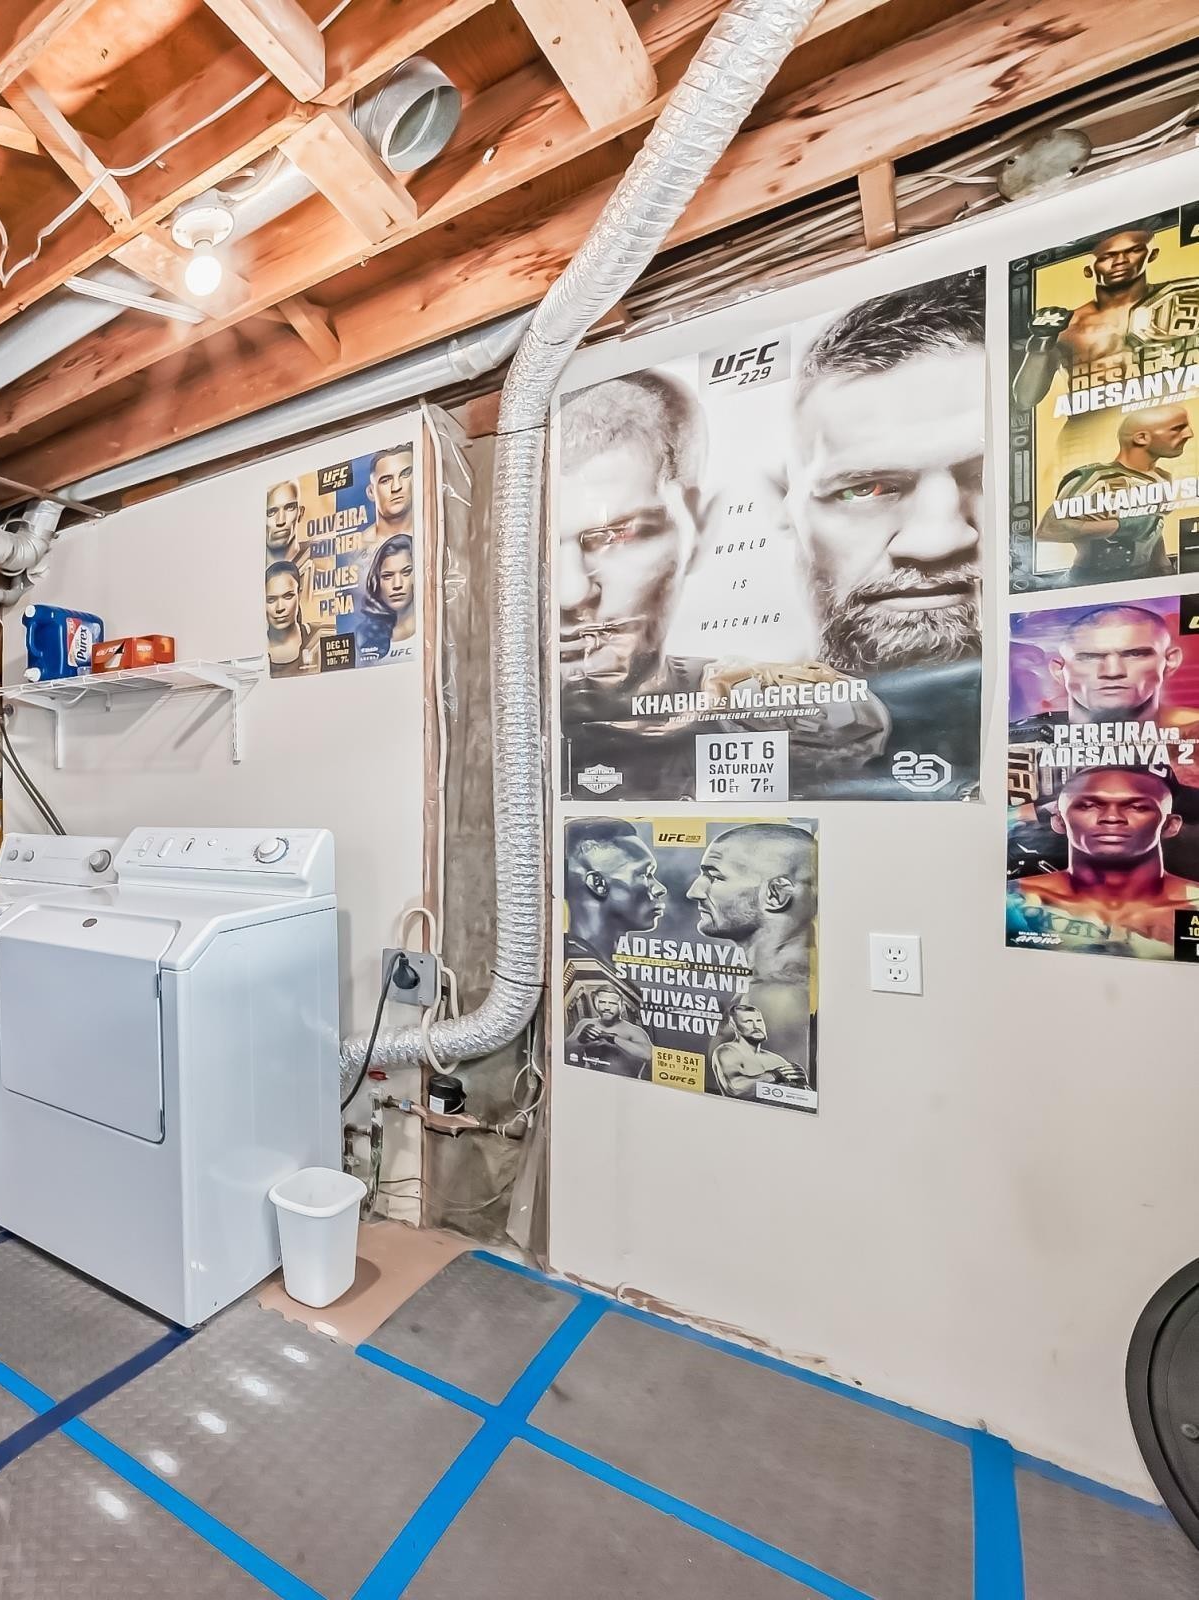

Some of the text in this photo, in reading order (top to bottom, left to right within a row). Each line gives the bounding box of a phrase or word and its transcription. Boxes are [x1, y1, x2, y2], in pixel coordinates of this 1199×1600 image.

[711, 341, 779, 378] UFC
[738, 366, 772, 386] 229
[1053, 364, 1199, 419] ADESANYA
[322, 466, 349, 483] UFC
[332, 478, 347, 489] 269
[1053, 477, 1199, 519] VOLKANOVS
[728, 502, 755, 515] THE
[306, 505, 368, 537] OLIVEIRA
[715, 537, 767, 554] WORLD
[313, 565, 359, 591] NUNES
[732, 579, 748, 590] IS
[319, 592, 355, 618] PEÑA
[701, 612, 781, 631] WATCHING
[76, 627, 88, 661] Purex
[326, 639, 350, 651] DEC 11
[390, 647, 412, 658] UFC
[631, 691, 707, 716] KHABIB
[730, 679, 869, 709] McGREGOR
[669, 708, 820, 723] WORLD LIGHTWEIGHT CHAMPIONSHIP
[1053, 720, 1158, 745] PEREIRA
[709, 741, 775, 761] OCT 6
[1039, 743, 1194, 767] ADESANYA 2
[709, 763, 775, 775] SATURDAY
[709, 778, 727, 793] 10
[750, 778, 762, 793] 7
[763, 785, 775, 793] PT
[658, 833, 686, 843] UFC
[615, 935, 749, 969] ADESANYA
[614, 962, 750, 994] STRICKLAND
[640, 986, 720, 1013] TUIVASA
[640, 1009, 720, 1037] VOLKOV
[657, 1051, 673, 1061] SEP
[683, 1056, 700, 1066] SAT
